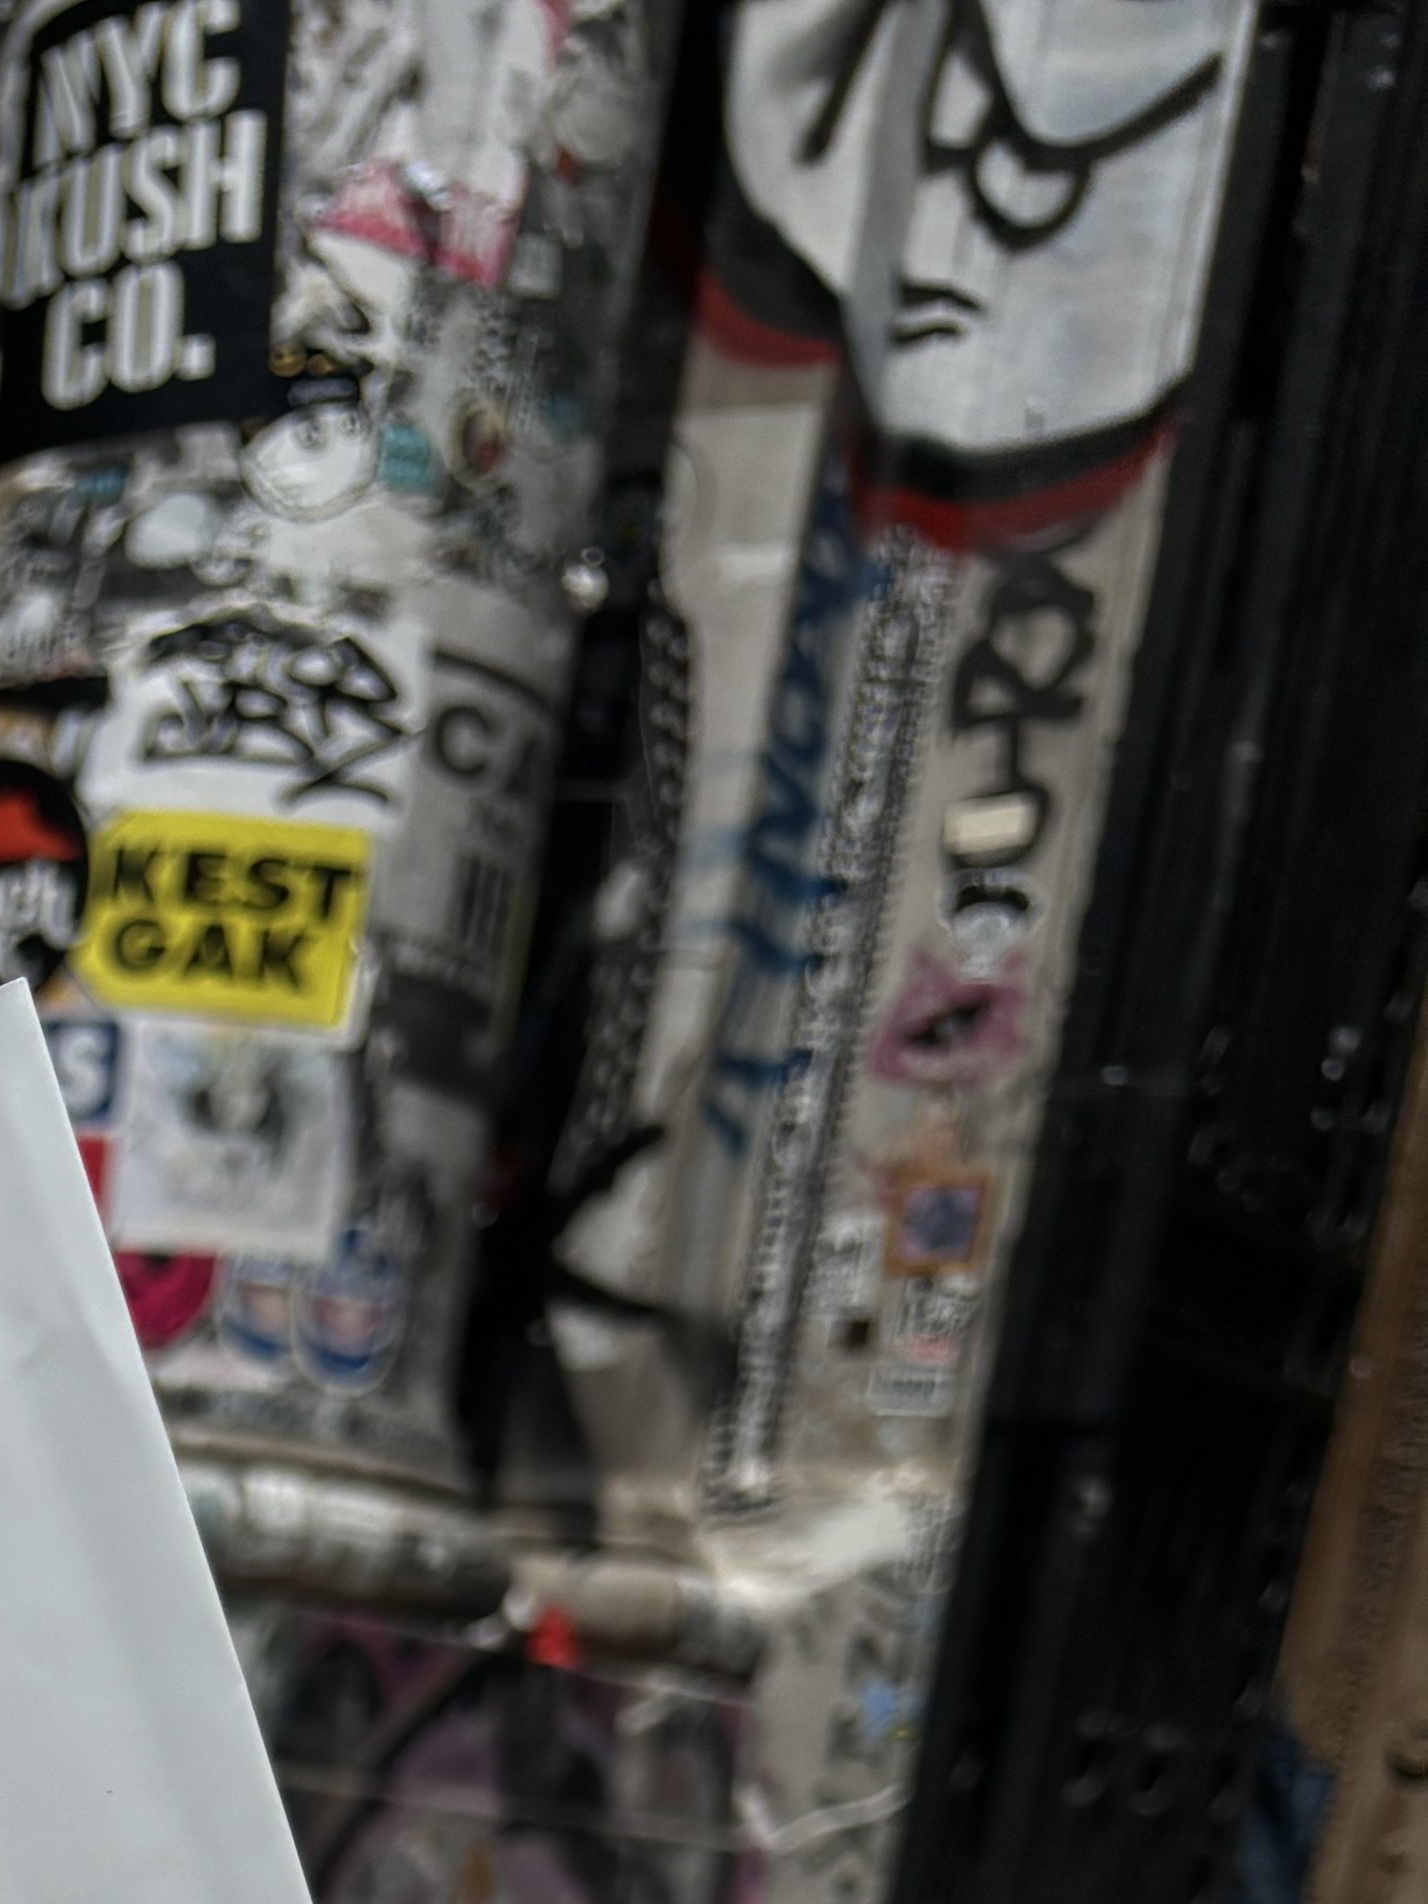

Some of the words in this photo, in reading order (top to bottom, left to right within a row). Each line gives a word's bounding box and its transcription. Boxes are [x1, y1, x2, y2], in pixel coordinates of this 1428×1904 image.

[32, 0, 240, 168] NYC
[41, 259, 217, 411] CO.
[111, 846, 353, 922] KEST
[114, 918, 307, 990] GAK
